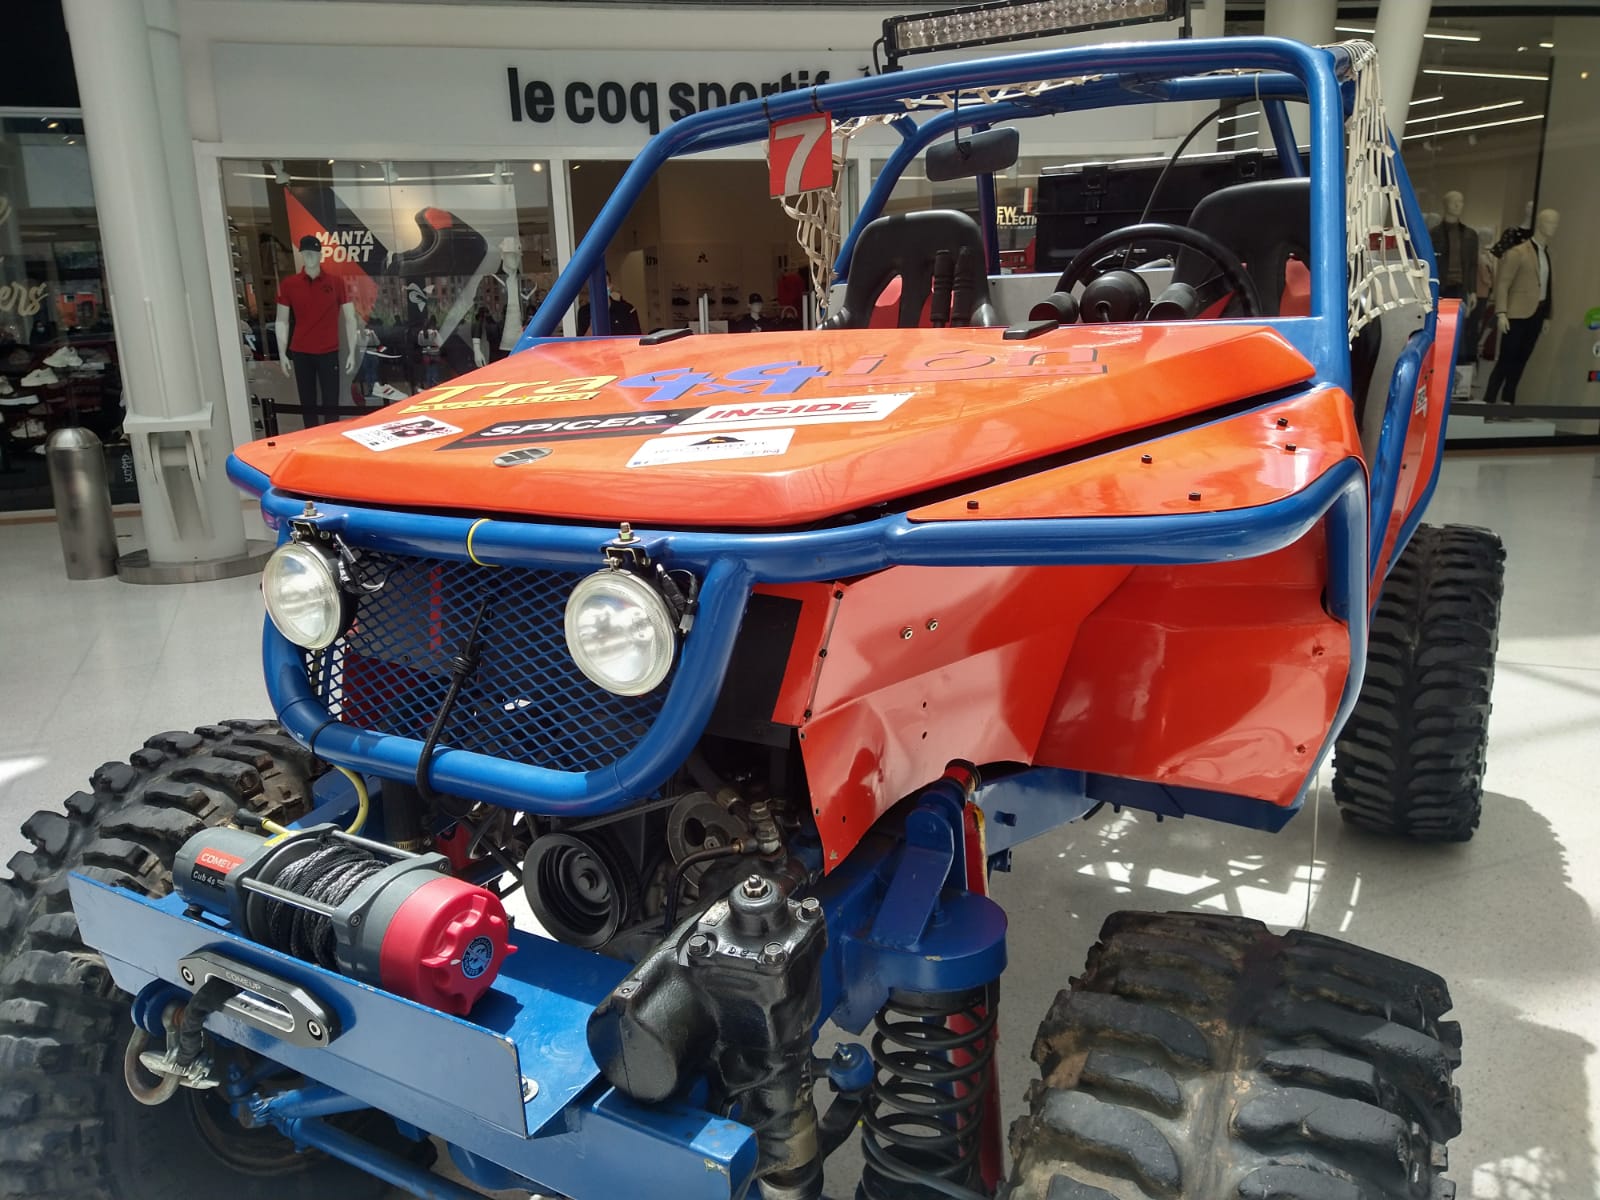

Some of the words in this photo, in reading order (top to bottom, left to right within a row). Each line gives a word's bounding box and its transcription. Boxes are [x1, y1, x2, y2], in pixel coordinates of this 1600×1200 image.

[507, 67, 555, 124] le
[565, 81, 660, 135] coq
[775, 117, 828, 196] 7
[997, 206, 1017, 221] EW
[315, 231, 375, 246] MANTA
[320, 245, 374, 263] PORT
[479, 414, 667, 437] SPICER
[705, 400, 878, 420] INSIDE
